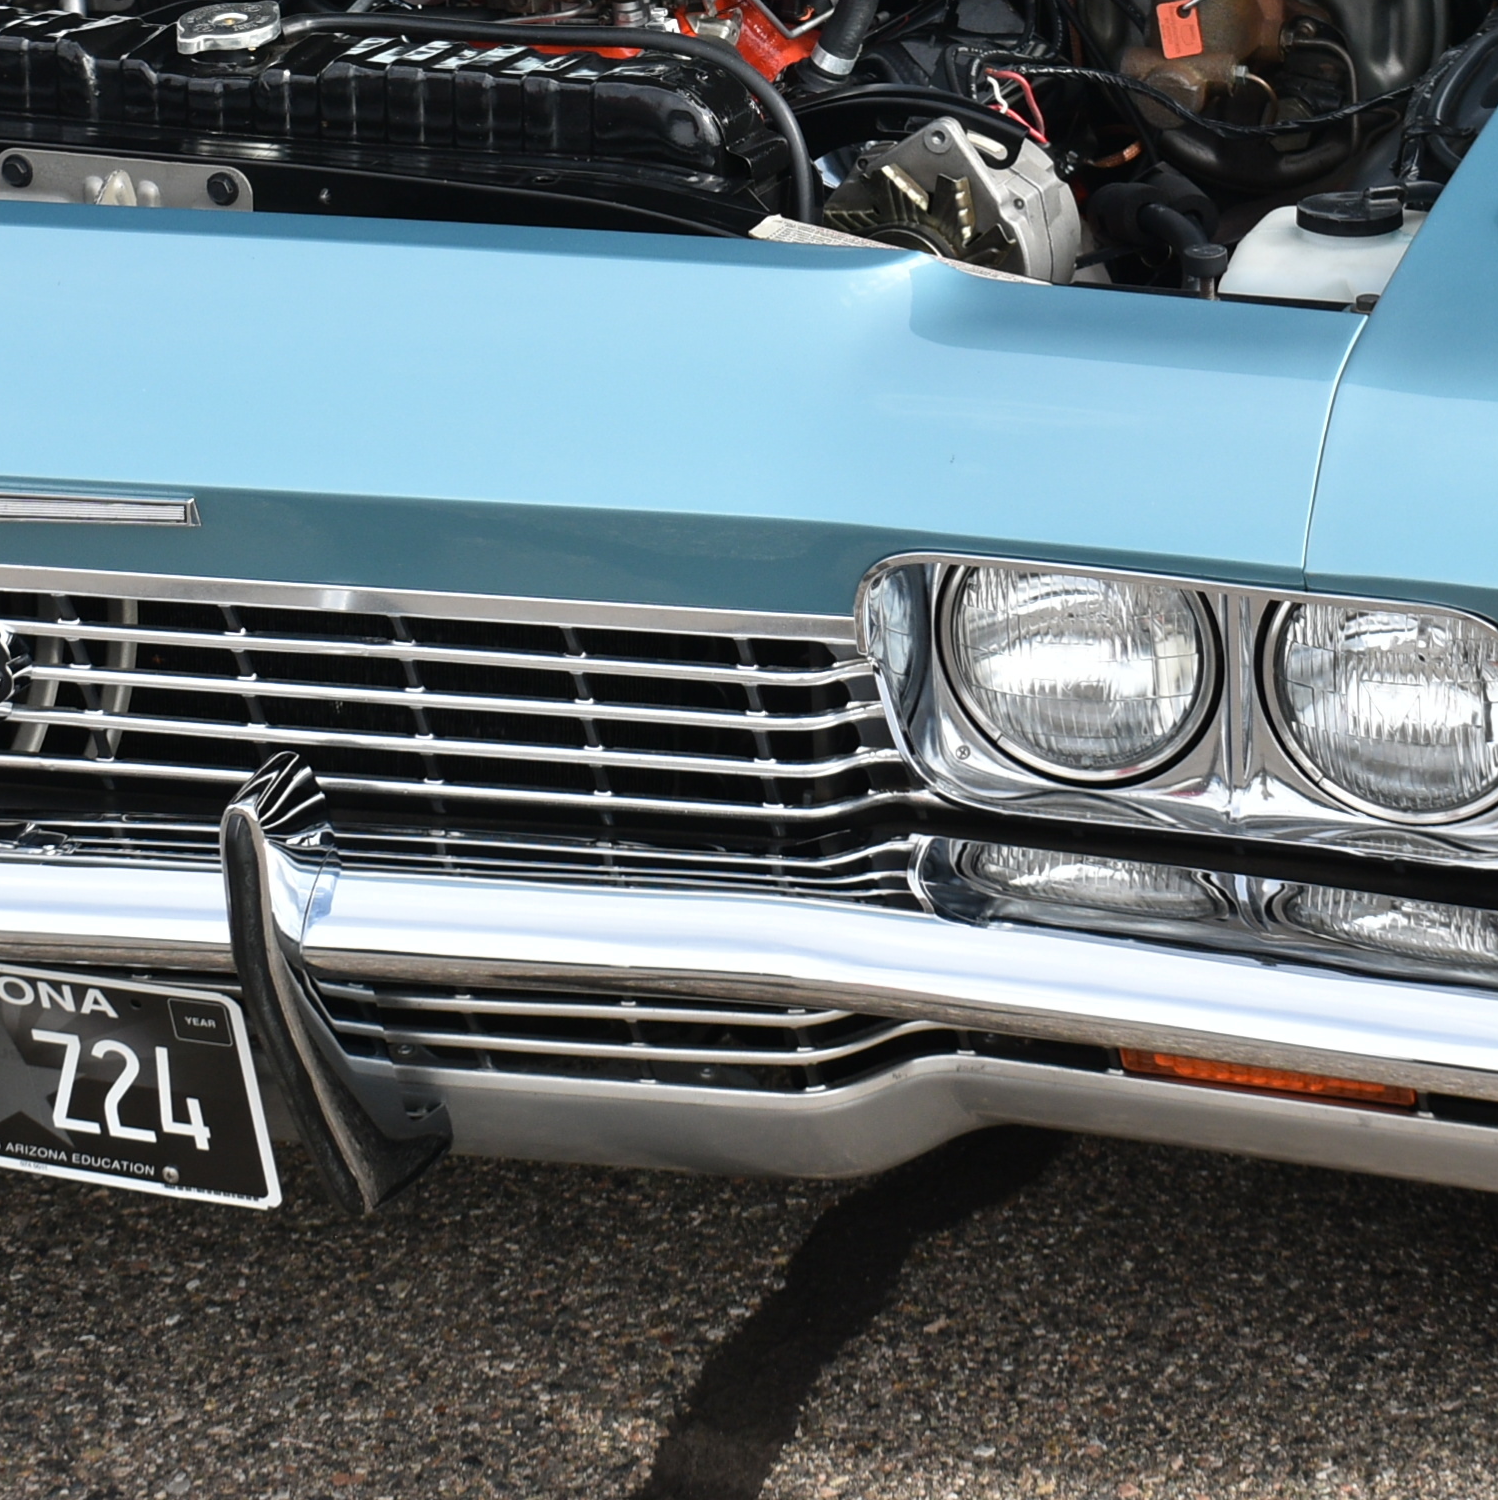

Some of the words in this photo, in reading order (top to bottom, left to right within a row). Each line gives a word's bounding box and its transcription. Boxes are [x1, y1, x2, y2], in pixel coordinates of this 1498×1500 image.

[183, 1015, 217, 1029] YEAR
[31, 1029, 211, 1151] Z24
[4, 1141, 69, 1163] ARIZONA
[71, 1152, 156, 1177] EDUCATION
